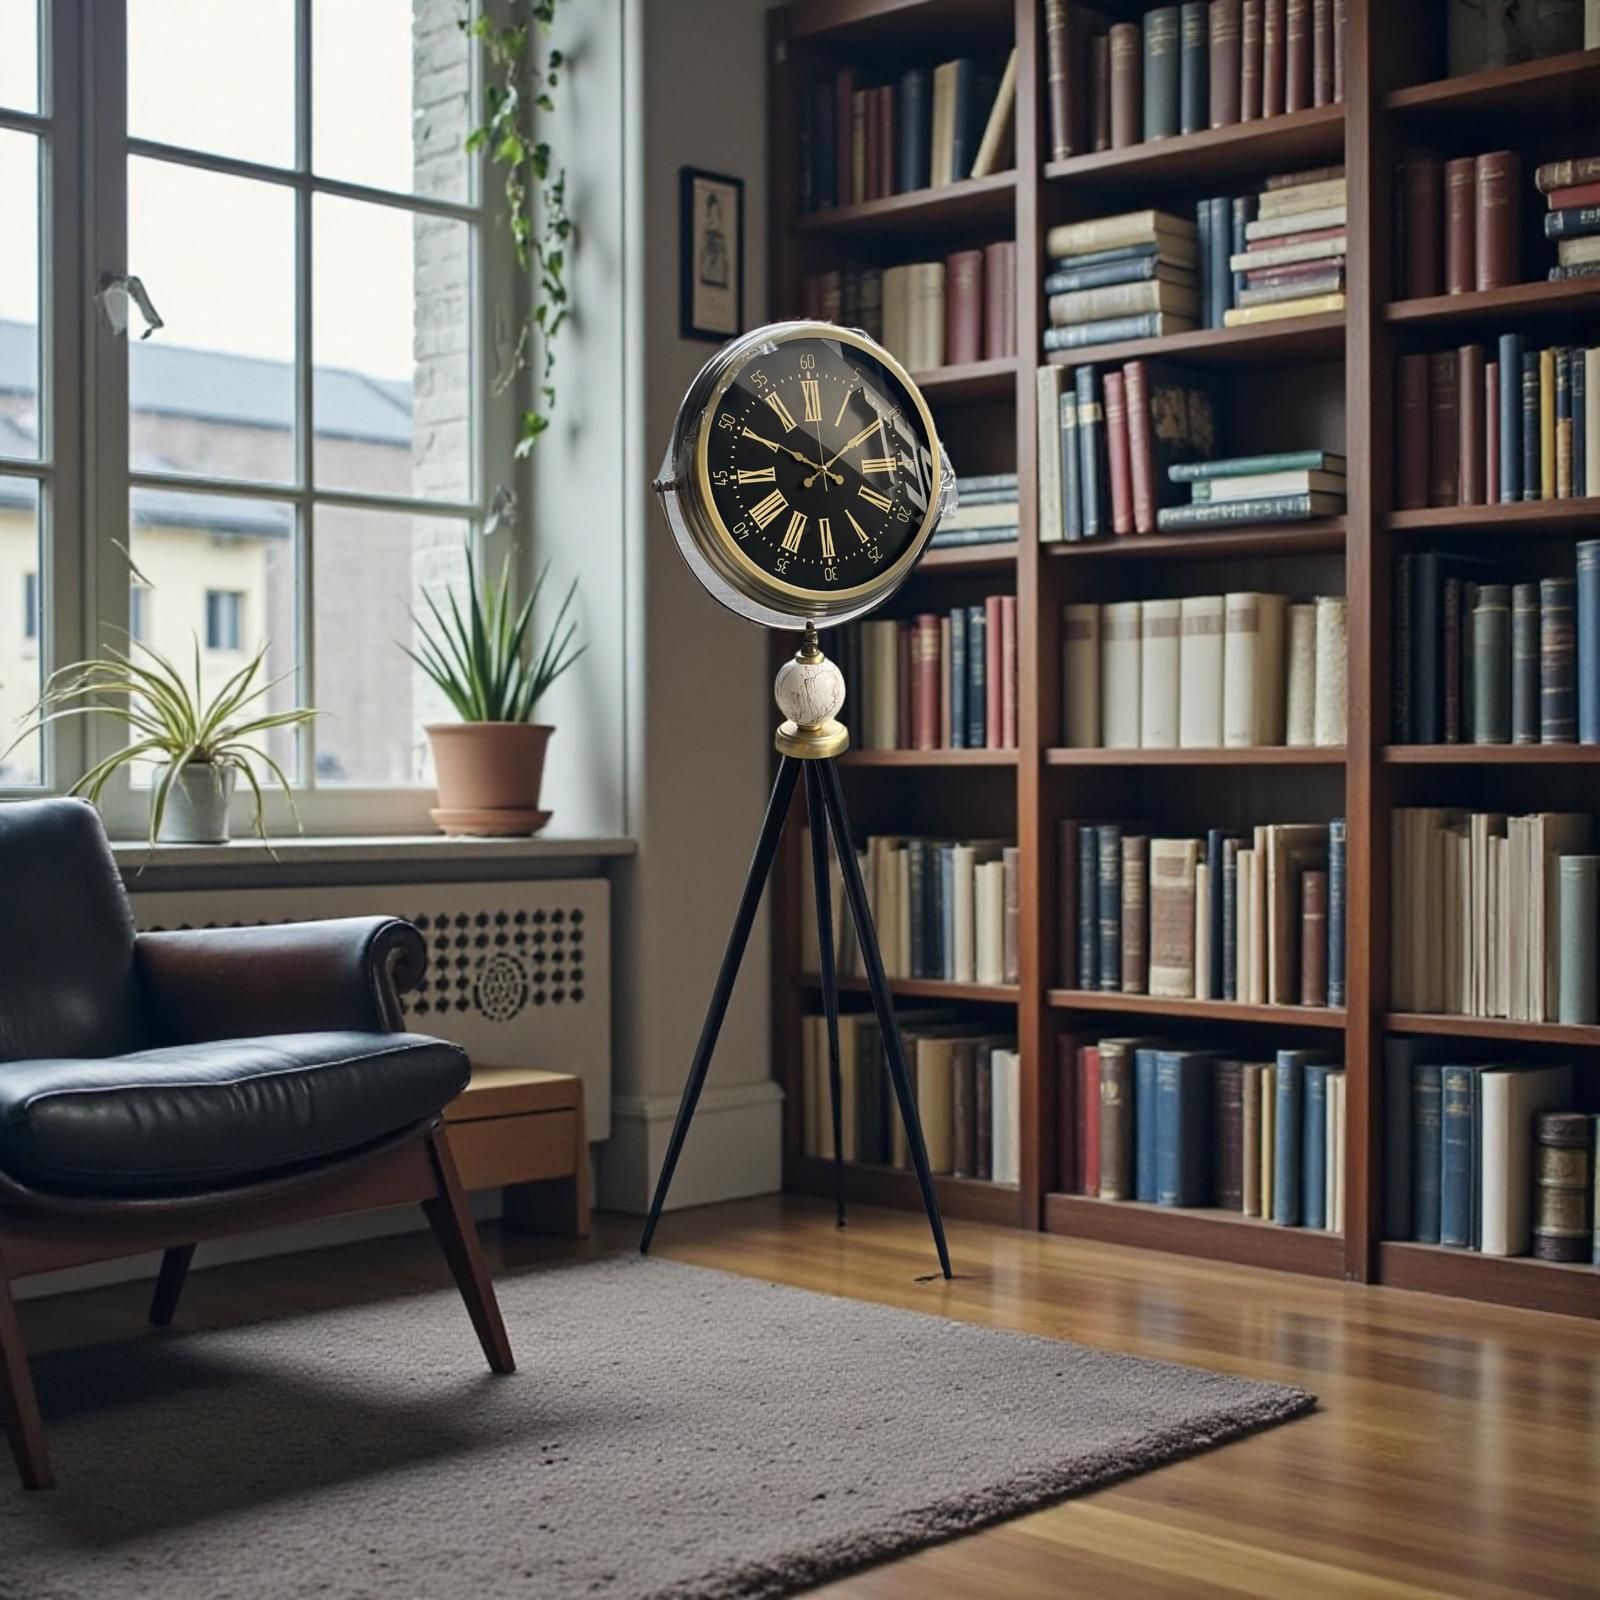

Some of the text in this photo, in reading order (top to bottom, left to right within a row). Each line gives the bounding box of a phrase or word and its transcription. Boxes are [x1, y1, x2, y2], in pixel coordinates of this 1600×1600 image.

[800, 354, 814, 369] 60
[751, 370, 769, 388] 55
[800, 380, 822, 422] XII
[765, 391, 798, 433] XI
[718, 413, 736, 431] 50
[742, 426, 780, 453] X
[737, 466, 777, 484] IX
[861, 457, 897, 474] III
[712, 470, 728, 485] 45
[857, 484, 893, 513] IV
[748, 488, 790, 530] VIII
[896, 506, 912, 523] 20
[732, 521, 750, 540] 40
[780, 510, 808, 554] VII
[844, 508, 870, 544] V
[818, 517, 837, 558] VI
[867, 545, 884, 564] 25
[774, 558, 790, 575] 35
[824, 566, 839, 582] 30
